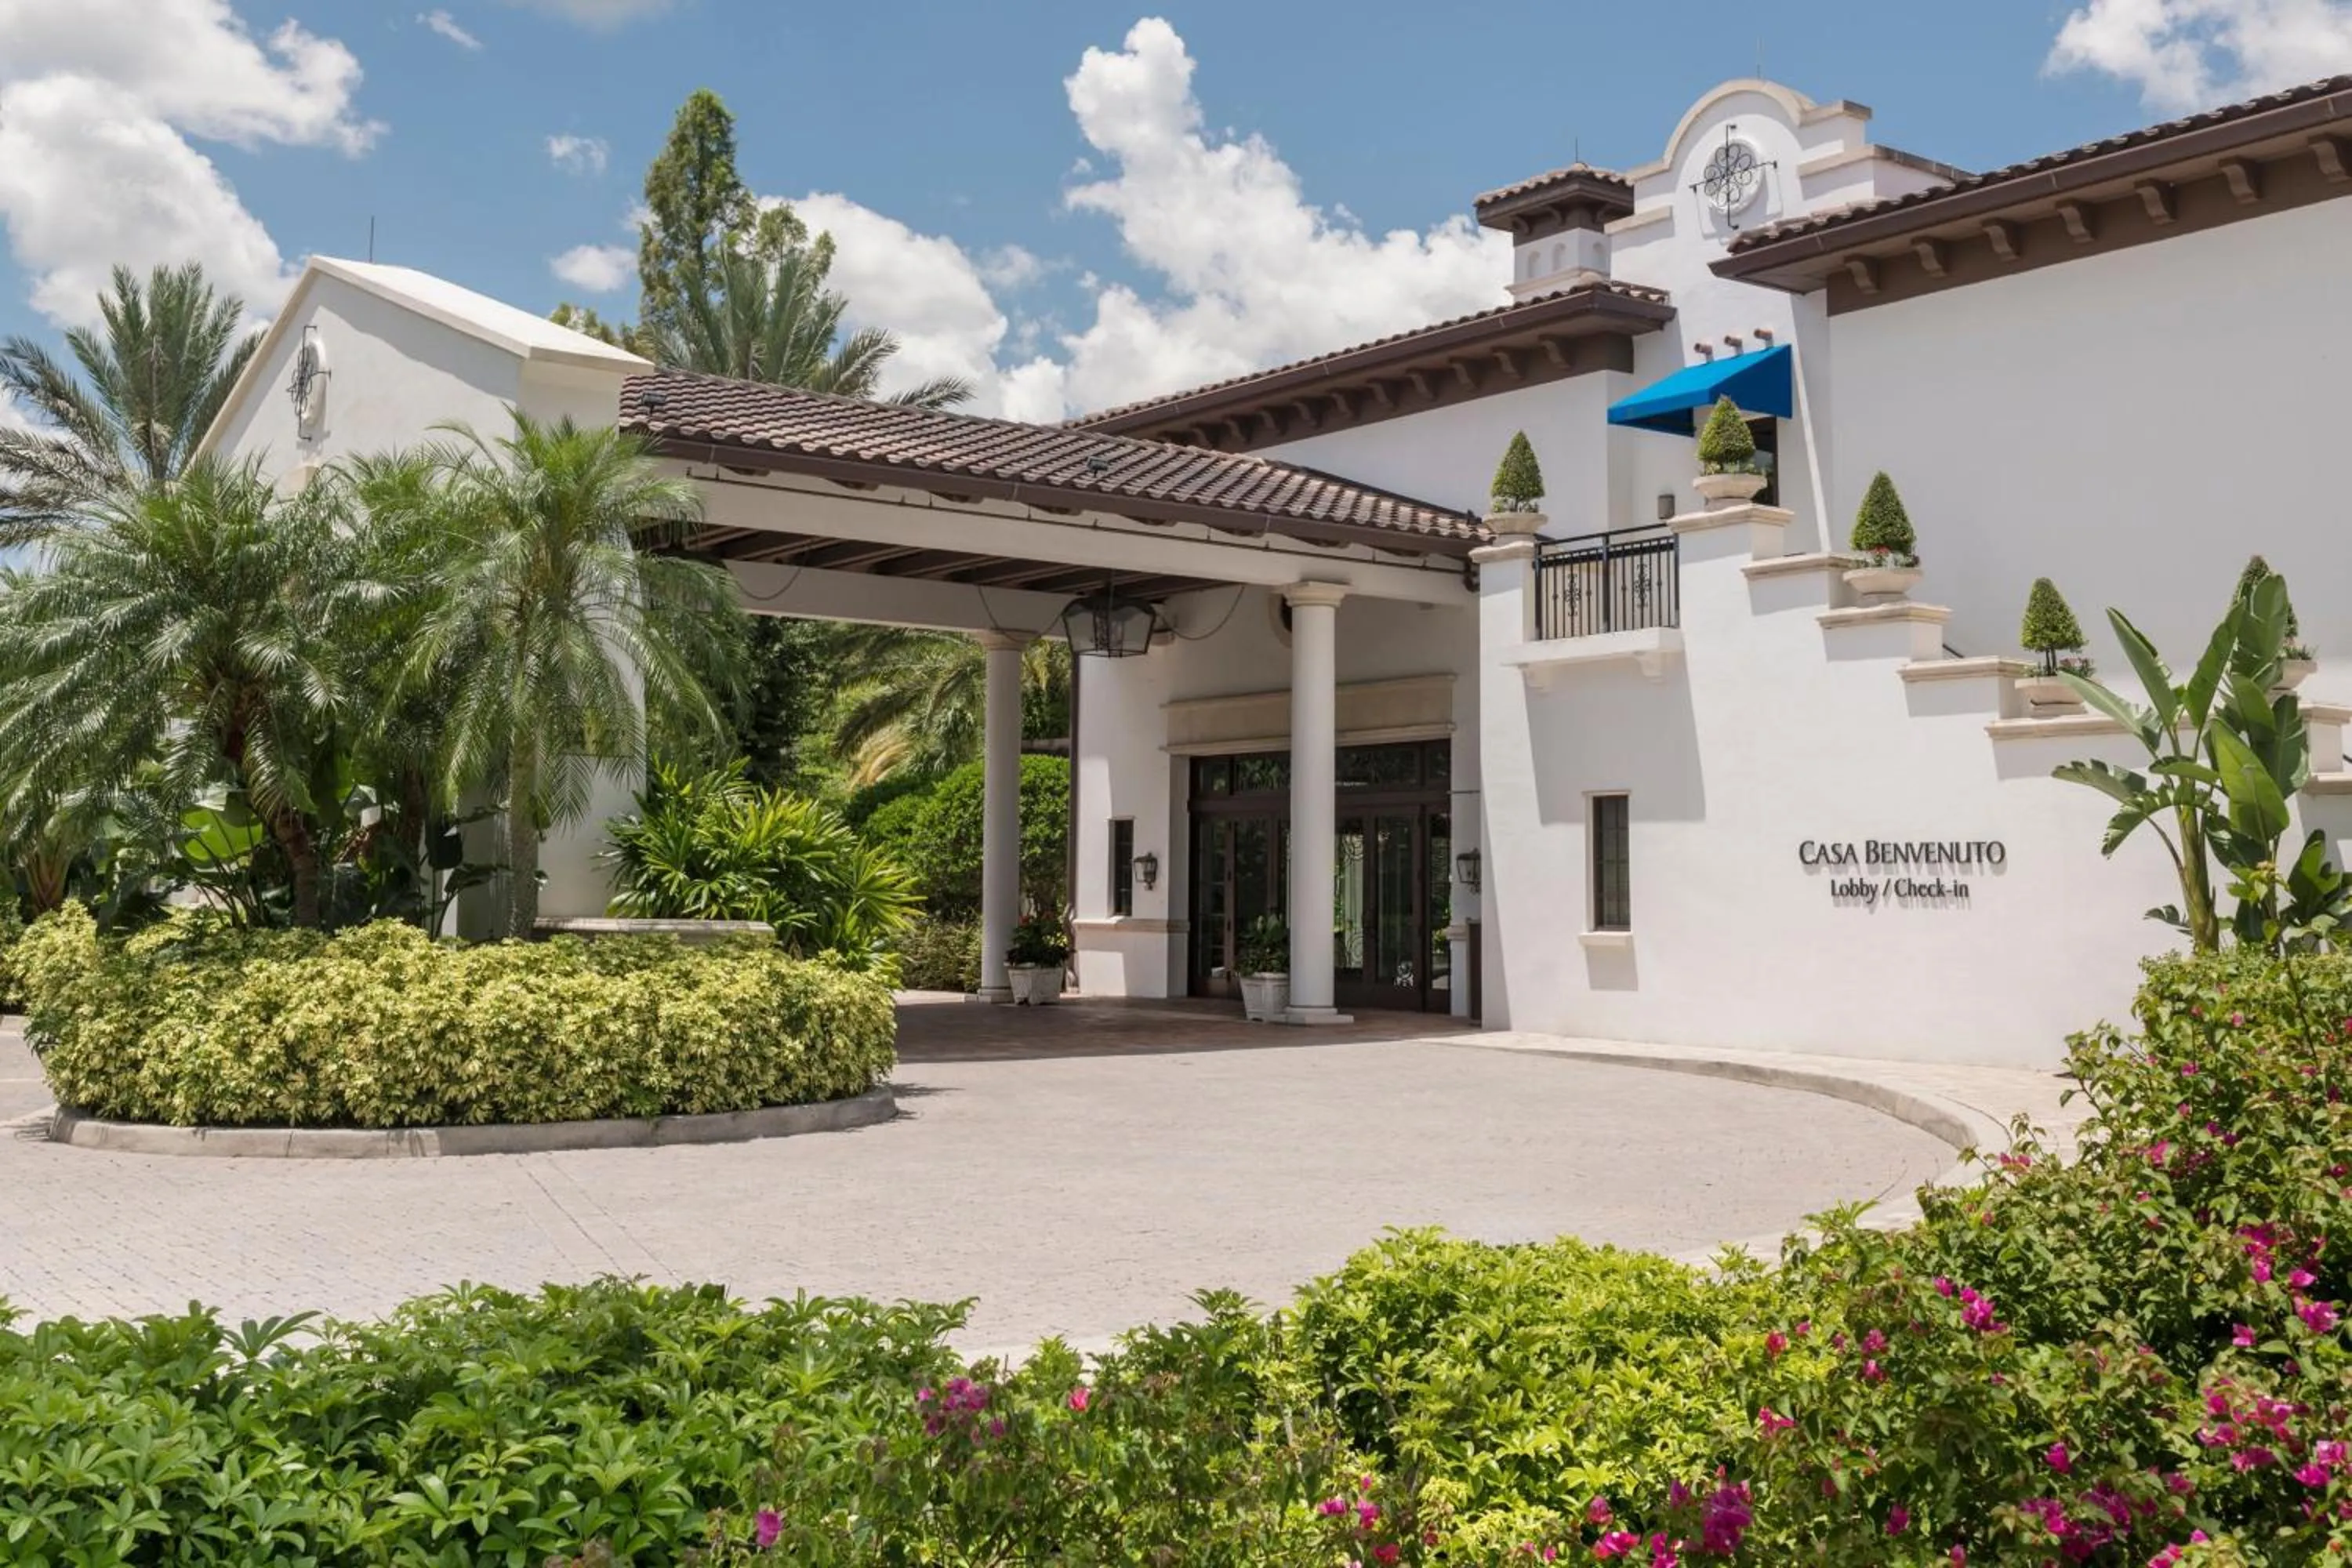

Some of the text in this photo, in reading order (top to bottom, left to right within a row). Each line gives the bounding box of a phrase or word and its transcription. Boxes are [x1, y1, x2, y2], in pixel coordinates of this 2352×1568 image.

[1799, 840, 2005, 865] CASA BENVENUTO
[1831, 878, 1969, 903] Lobby / Check-in
